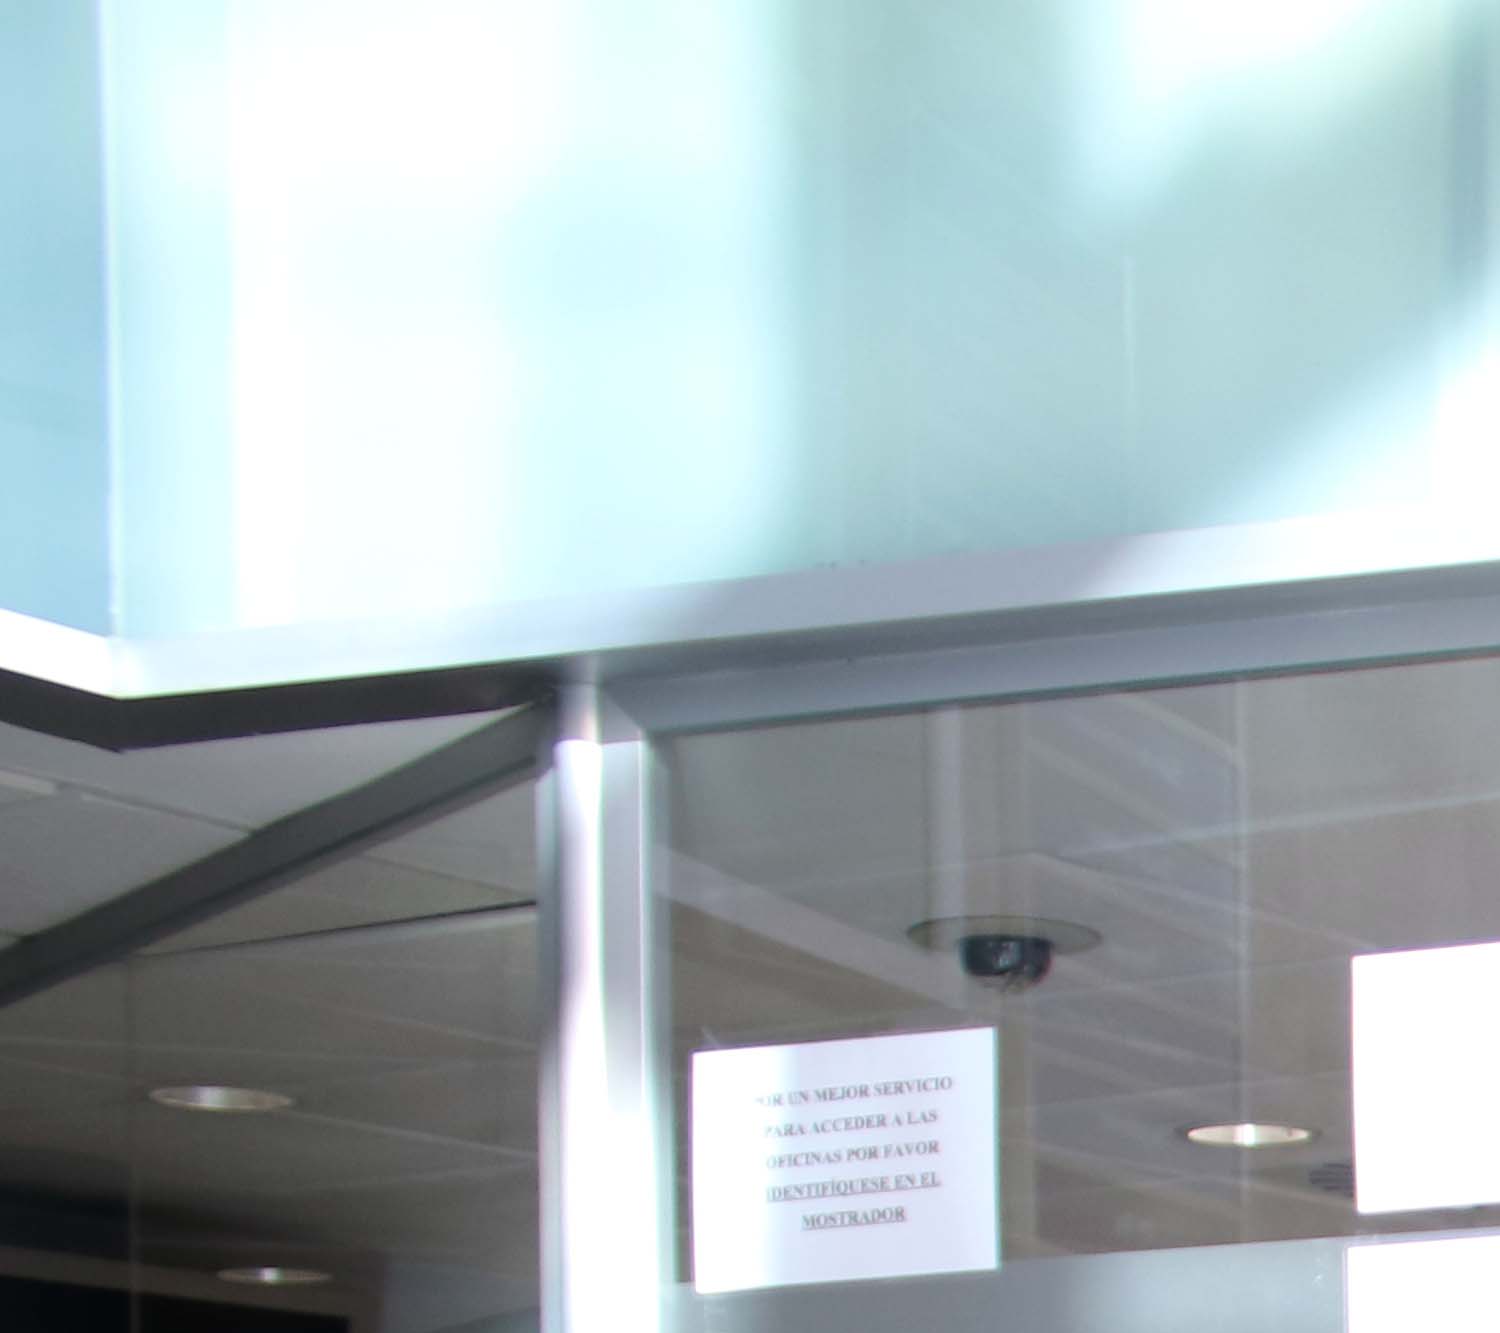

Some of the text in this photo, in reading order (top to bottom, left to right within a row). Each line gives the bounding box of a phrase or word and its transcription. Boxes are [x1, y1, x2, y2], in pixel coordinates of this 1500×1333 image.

[787, 1091, 810, 1106] UN
[814, 1083, 870, 1103] MEJOR
[873, 1076, 953, 1098] SERVICIO
[811, 1114, 888, 1135] ACCEDER
[891, 1112, 904, 1127] A
[906, 1109, 939, 1125] LAS
[766, 1140, 940, 1169] OFICINAS POR FAVOR
[894, 1173, 917, 1191] EN
[920, 1170, 942, 1188] EL
[801, 1206, 908, 1230] MOSTRADOR
